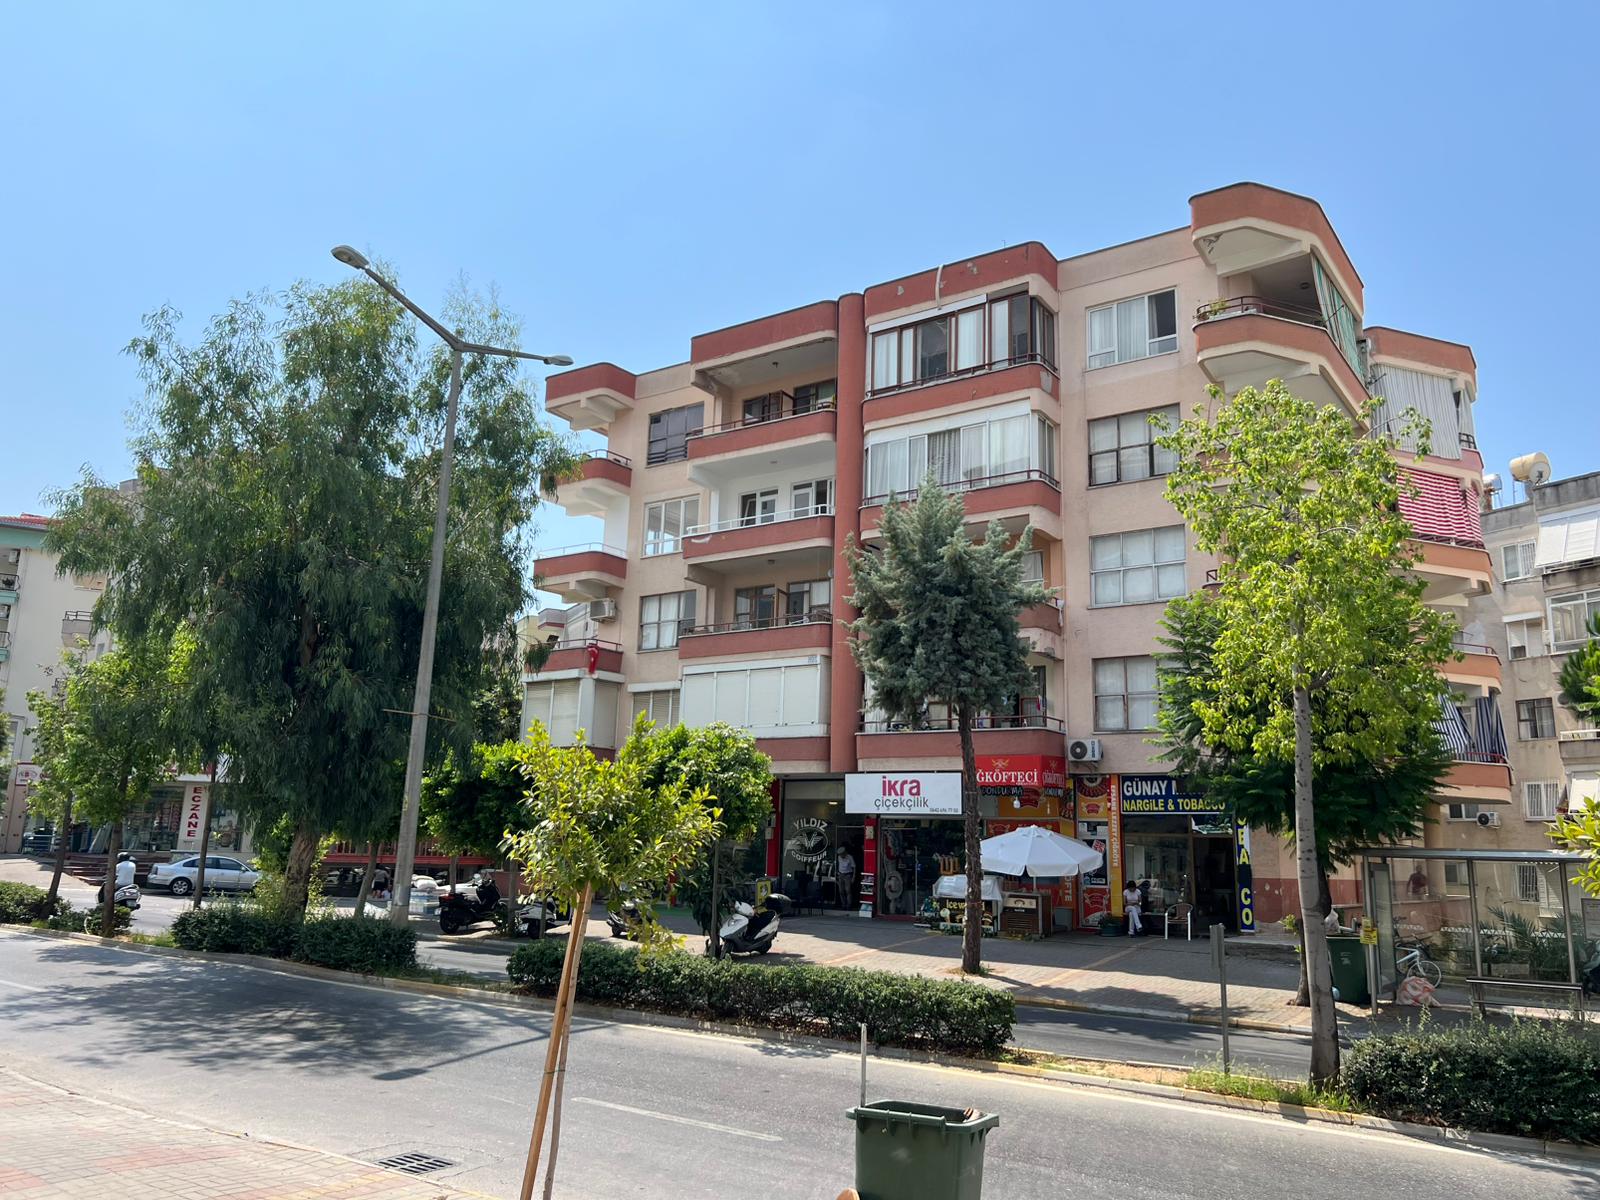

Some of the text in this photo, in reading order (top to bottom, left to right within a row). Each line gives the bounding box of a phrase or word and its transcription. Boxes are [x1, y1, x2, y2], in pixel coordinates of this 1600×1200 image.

[1123, 778, 1168, 796] GÜNAY
[187, 787, 202, 837] ECZANE
[1167, 799, 1175, 811] &
[793, 817, 828, 831] YILDIZ
[791, 851, 827, 862] COIFFEUR
